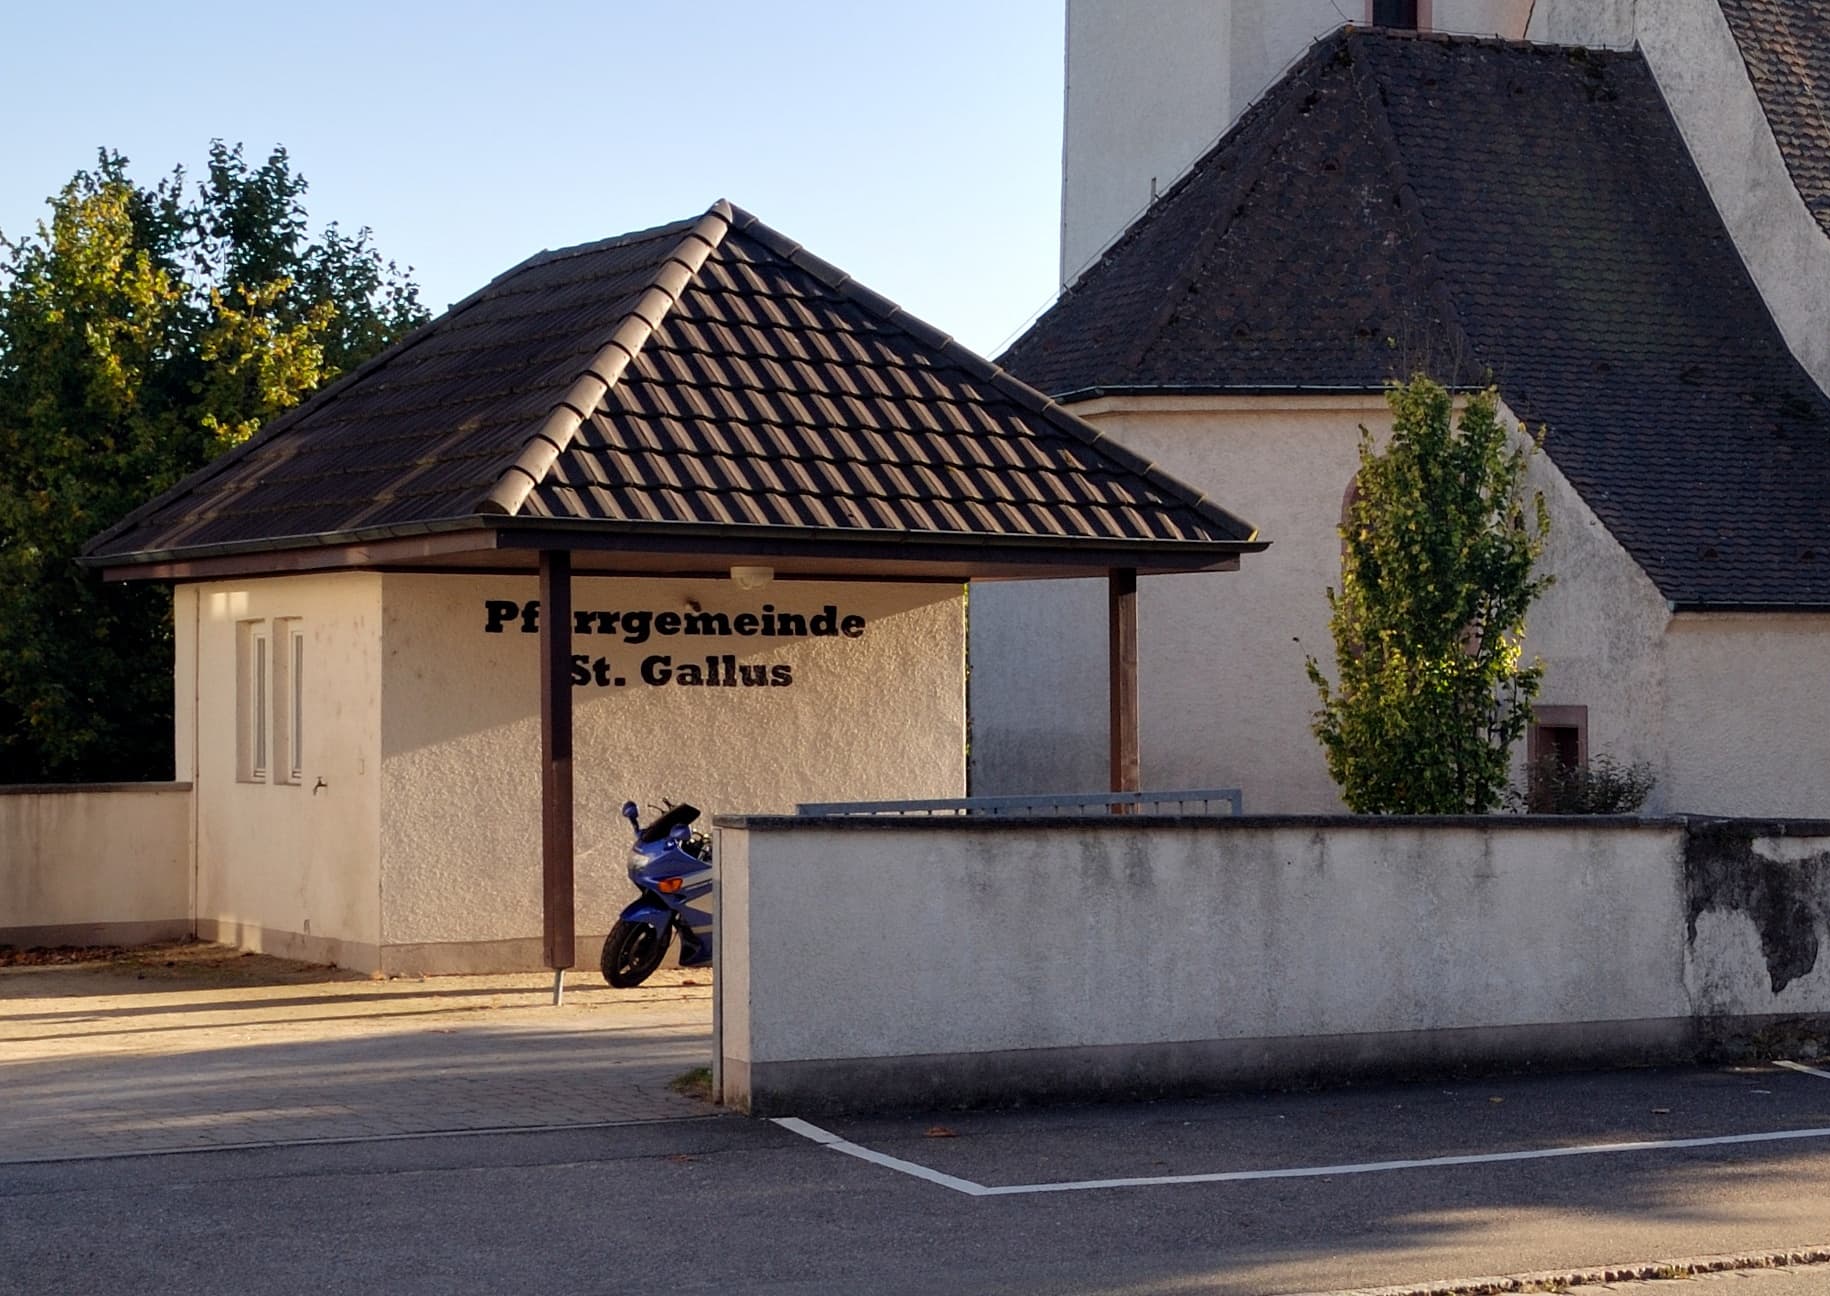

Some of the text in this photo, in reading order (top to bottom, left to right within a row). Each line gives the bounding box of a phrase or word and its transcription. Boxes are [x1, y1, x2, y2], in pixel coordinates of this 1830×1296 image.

[485, 599, 866, 643] Pfrrgemeinde
[569, 654, 793, 688] St. Gallus
